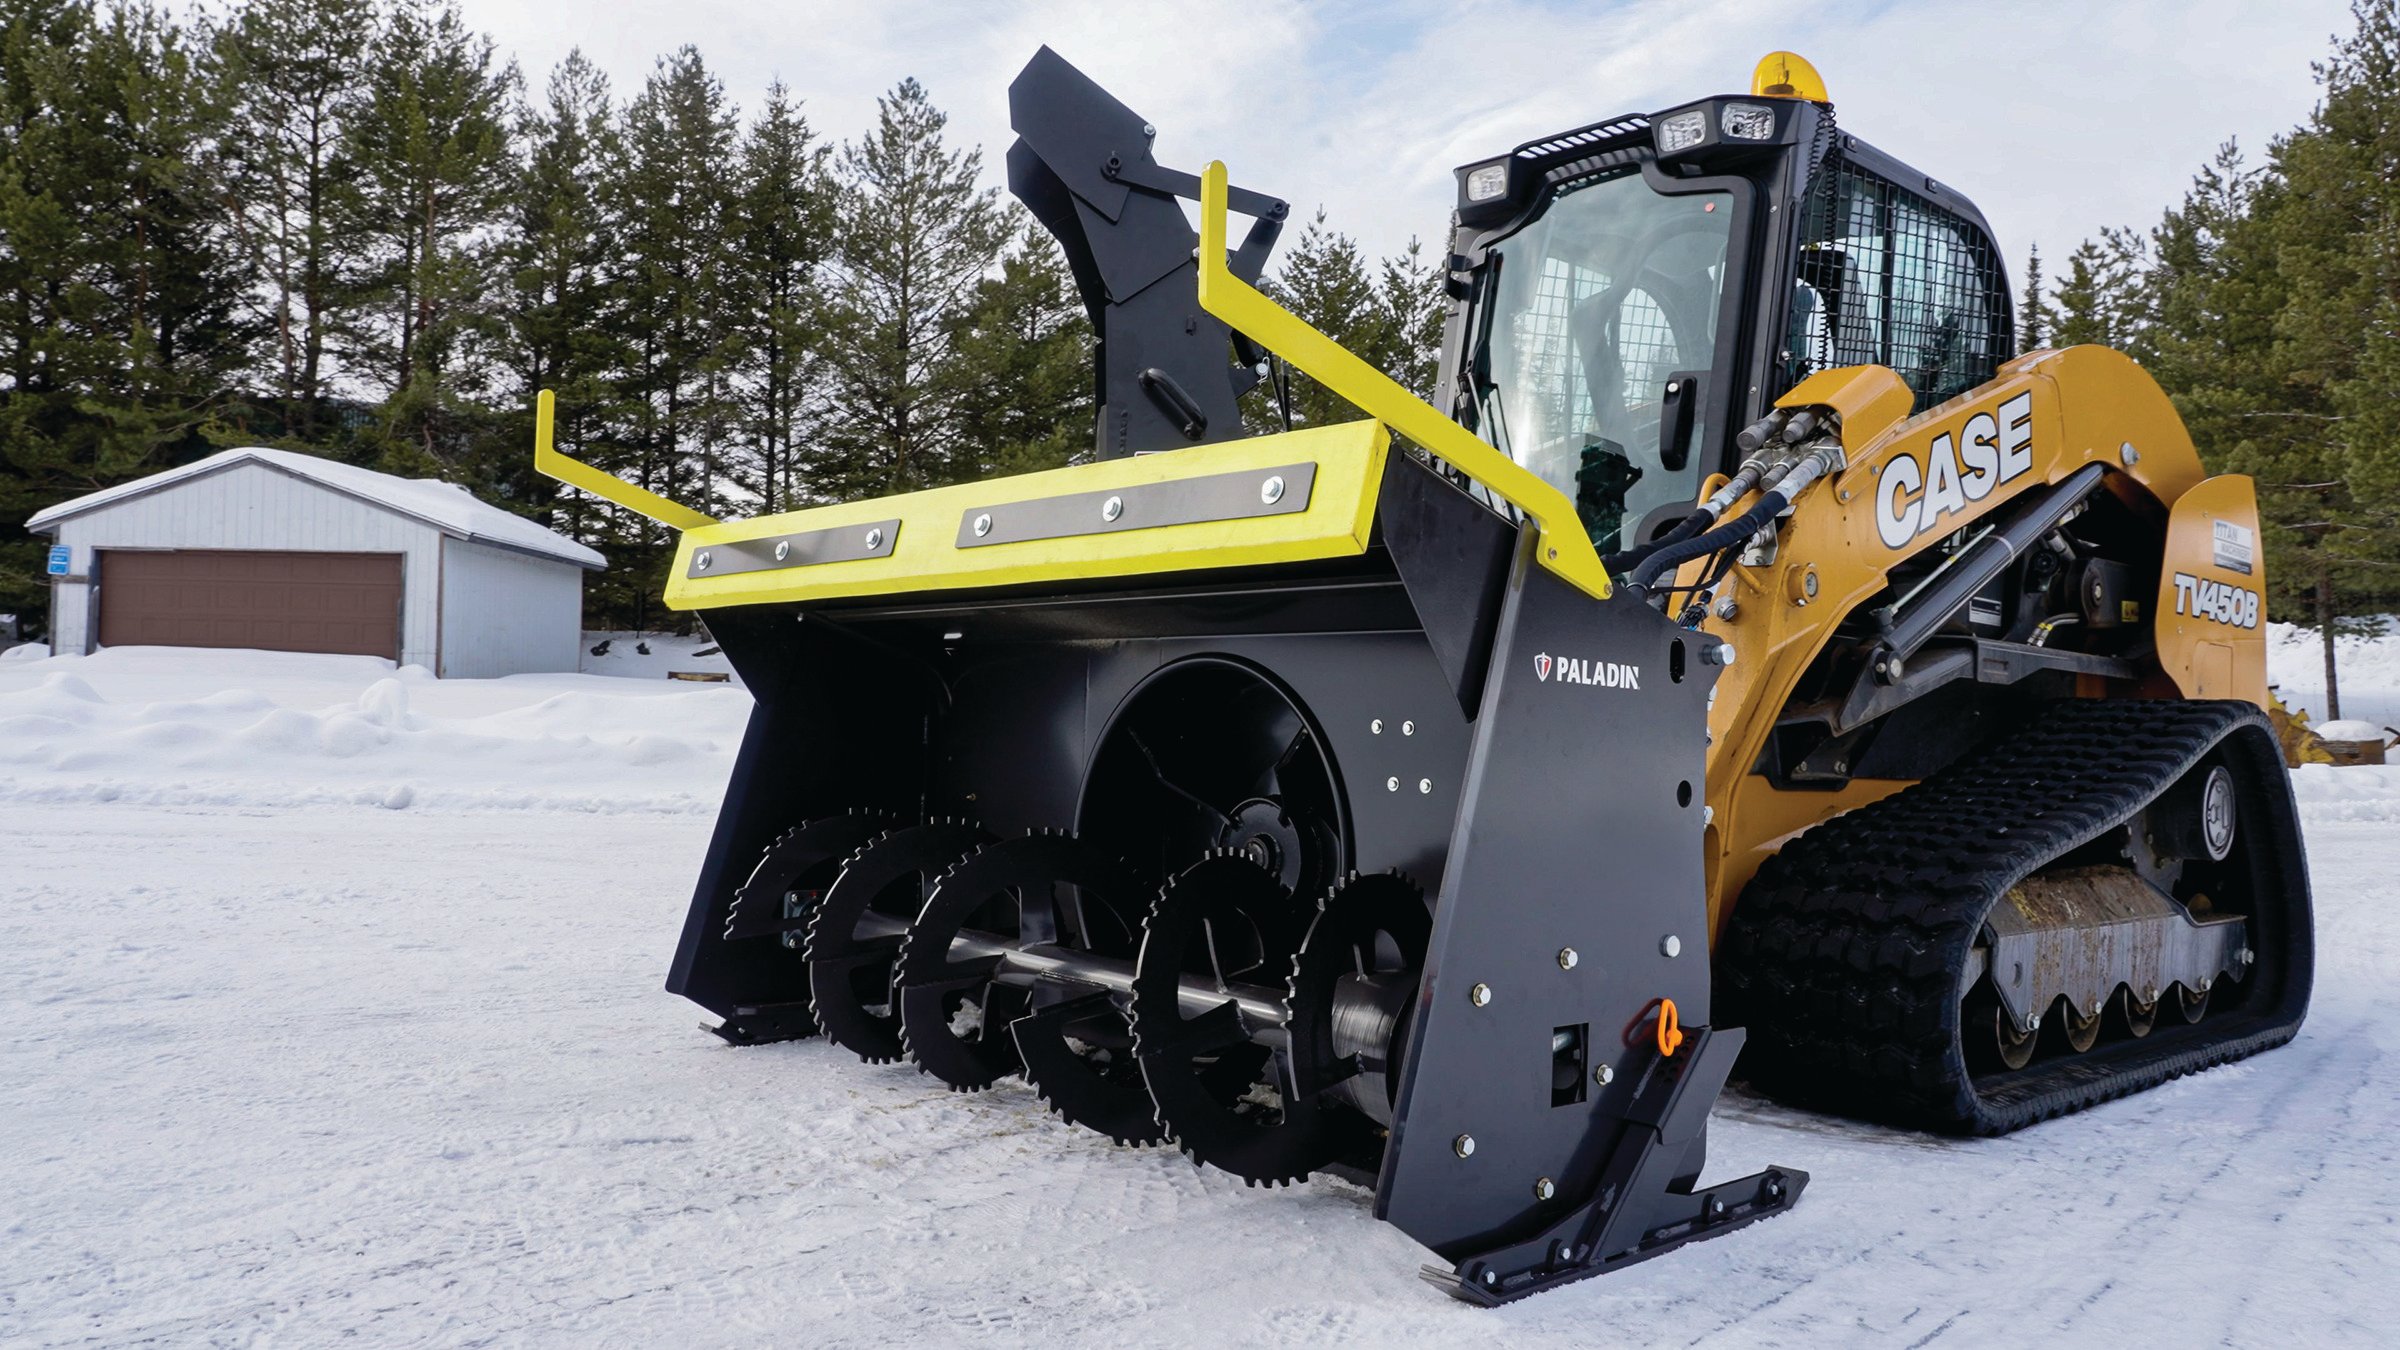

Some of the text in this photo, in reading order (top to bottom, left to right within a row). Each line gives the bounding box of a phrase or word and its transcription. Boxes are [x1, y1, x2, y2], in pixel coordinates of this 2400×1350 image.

[1876, 389, 2032, 550] CASE
[2215, 521, 2239, 541] TITAN
[2174, 571, 2258, 629] TV450B
[1556, 656, 1639, 690] PALADIN
